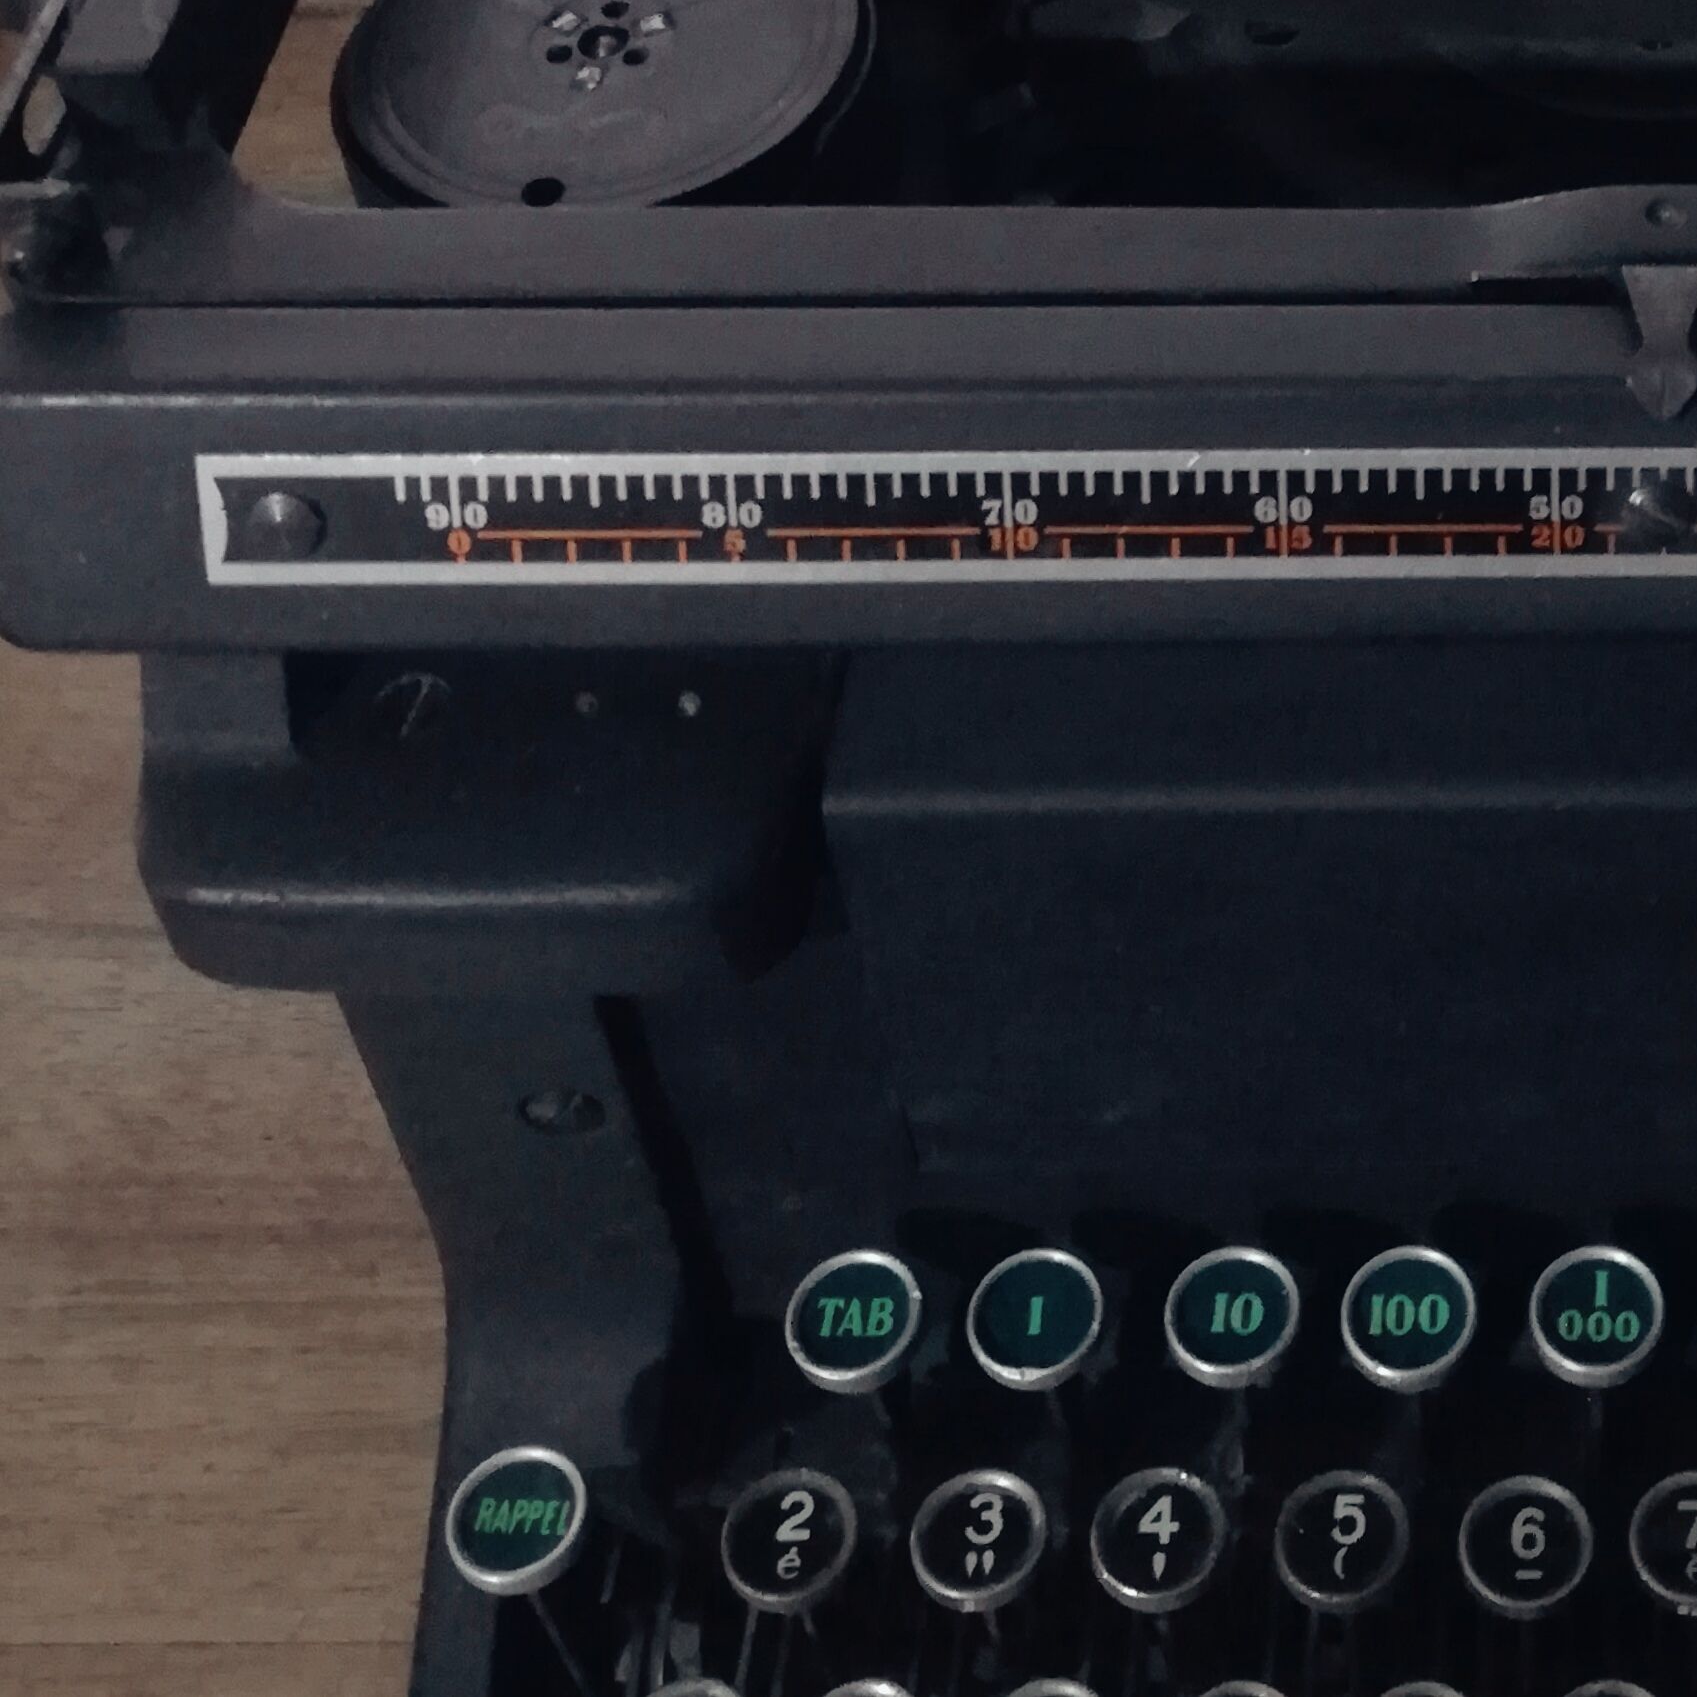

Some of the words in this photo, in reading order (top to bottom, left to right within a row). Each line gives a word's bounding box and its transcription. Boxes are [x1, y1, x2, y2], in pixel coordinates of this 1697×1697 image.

[425, 501, 488, 531] 90
[702, 500, 762, 530] 80
[981, 498, 1038, 526] 70
[1254, 495, 1313, 524] 60
[1529, 495, 1583, 521] 50
[1531, 525, 1584, 550] 20
[817, 1297, 894, 1337] TAB
[1210, 1292, 1264, 1336] 10
[1369, 1293, 1450, 1336] 100
[1557, 1308, 1640, 1343] 000
[775, 1490, 815, 1542] 2
[964, 1493, 1003, 1545] 3
[1138, 1495, 1180, 1545] 4
[1331, 1493, 1366, 1545] 5
[1510, 1506, 1546, 1560] 6
